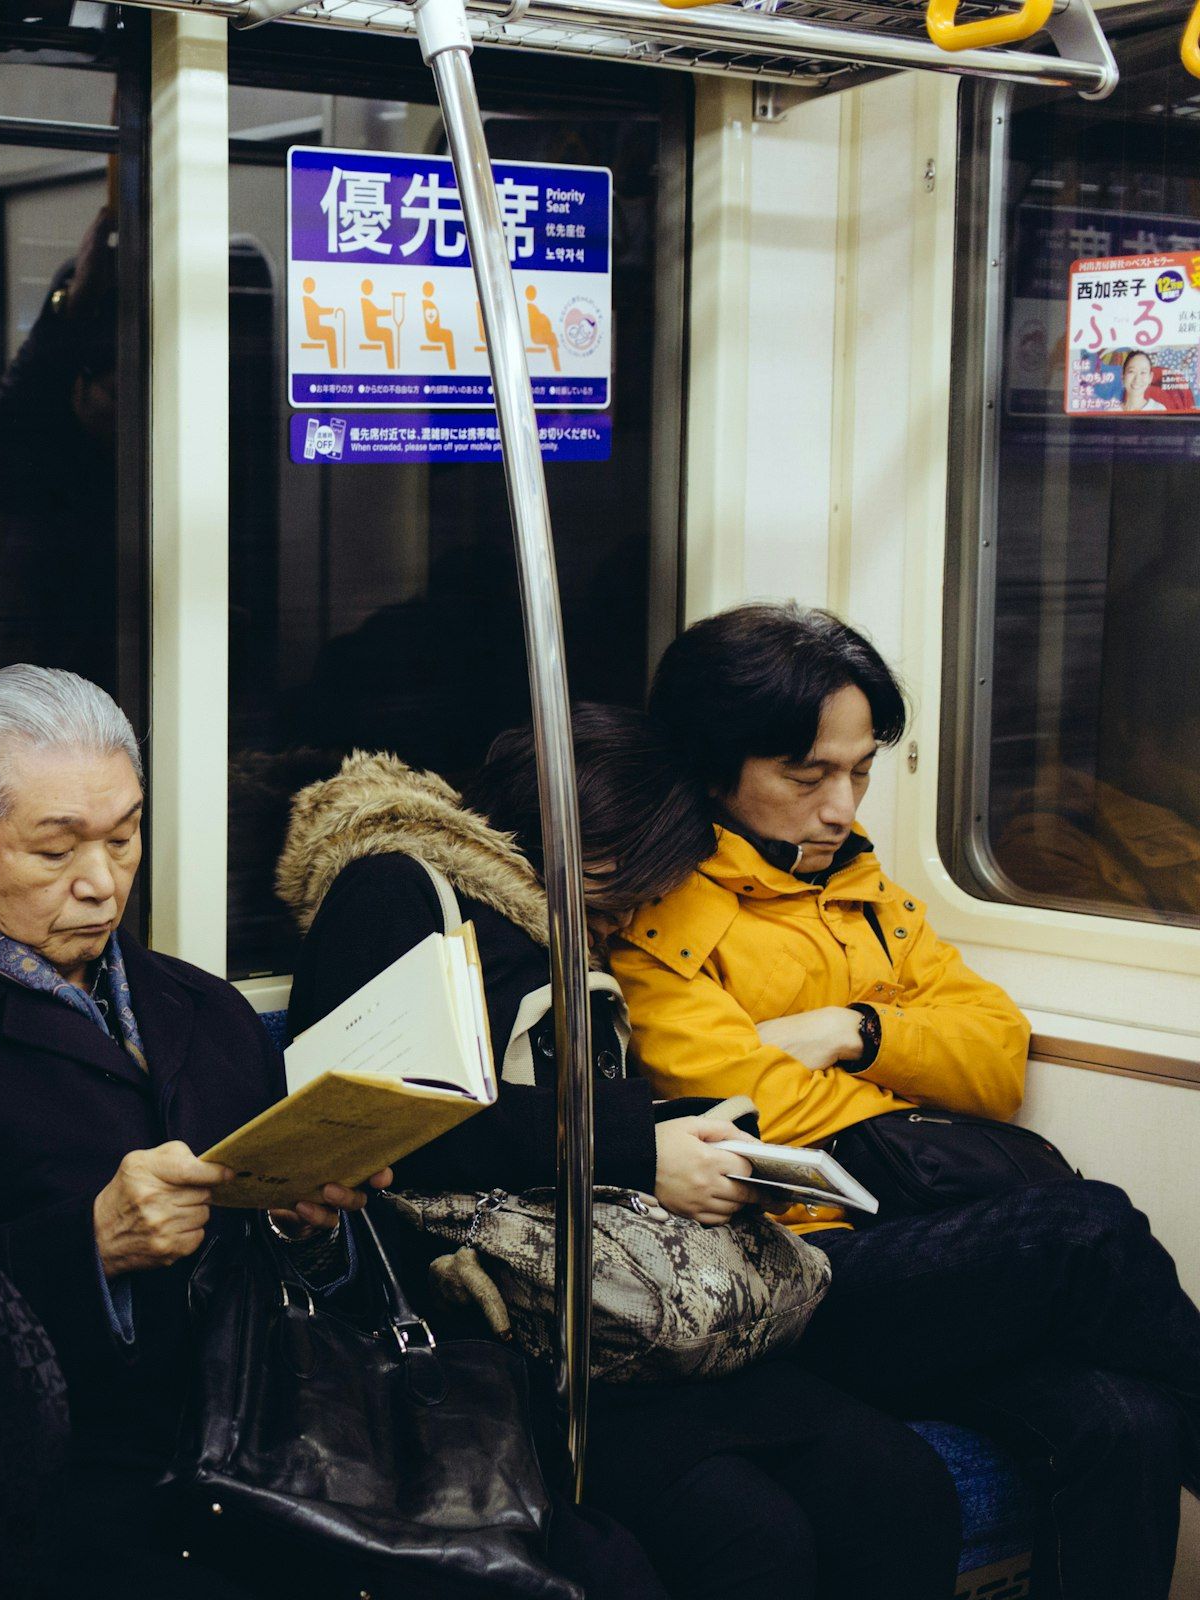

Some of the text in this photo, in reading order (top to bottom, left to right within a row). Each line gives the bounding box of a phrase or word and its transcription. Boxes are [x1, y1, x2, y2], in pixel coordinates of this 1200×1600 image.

[546, 188, 585, 206] Priority
[320, 166, 539, 262] 優先席
[546, 201, 570, 214] Seat
[545, 247, 585, 263] 노약자석
[1077, 278, 1147, 300] 西加奈子
[1073, 300, 1164, 350] ふる
[316, 440, 333, 449] OFF
[351, 443, 371, 451] When
[372, 443, 404, 452] crowded,
[405, 443, 428, 452] please
[429, 443, 442, 451] turn
[443, 442, 453, 451] off
[454, 443, 469, 453] your
[470, 442, 492, 451] mobile
